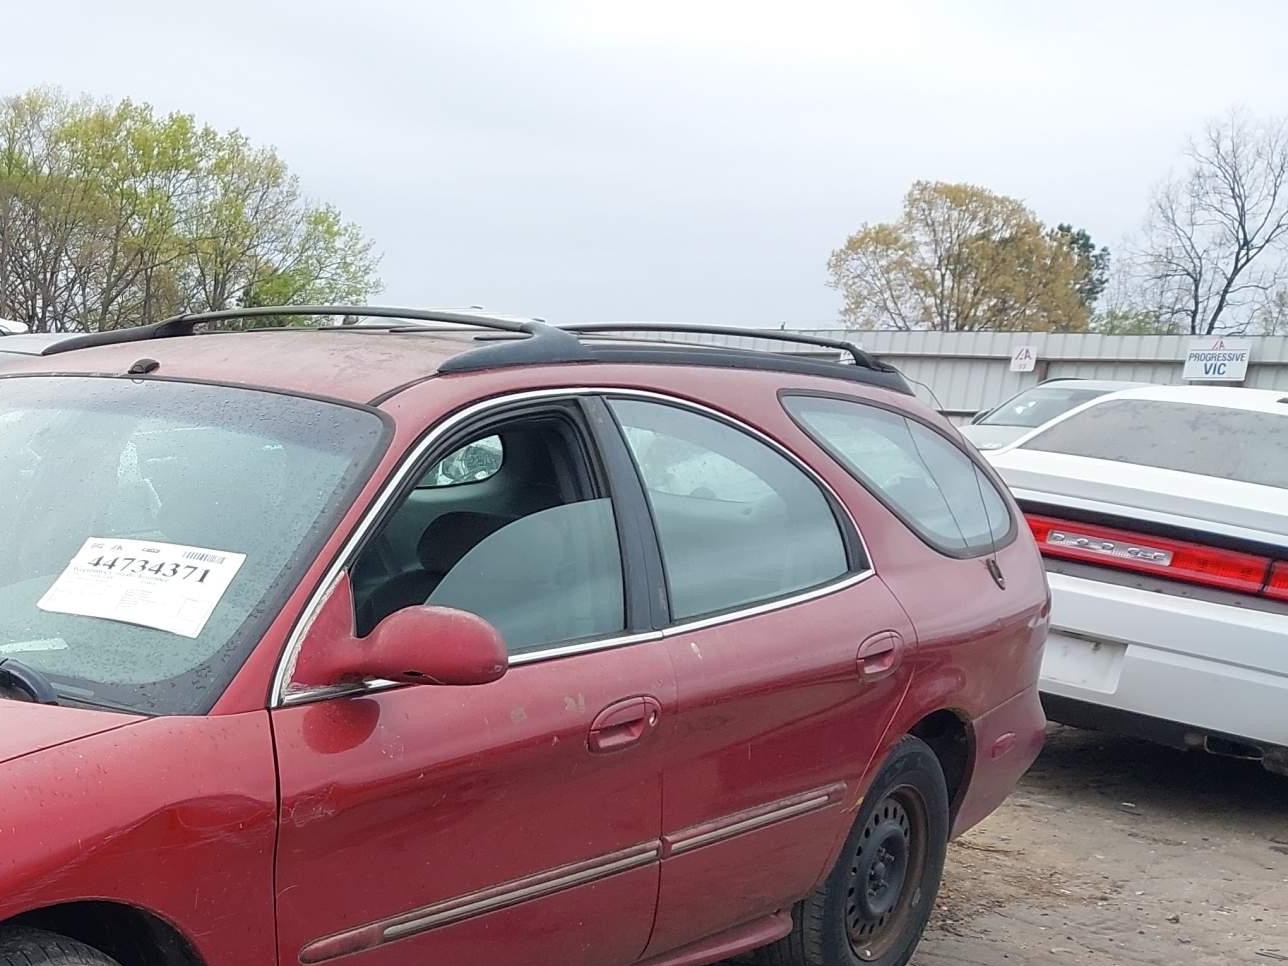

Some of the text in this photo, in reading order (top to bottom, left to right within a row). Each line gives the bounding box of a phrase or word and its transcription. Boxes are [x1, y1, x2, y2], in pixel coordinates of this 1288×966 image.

[1188, 352, 1247, 362] PROGRESSIVE
[1204, 362, 1227, 376] VIC
[87, 555, 211, 584] 44734371
